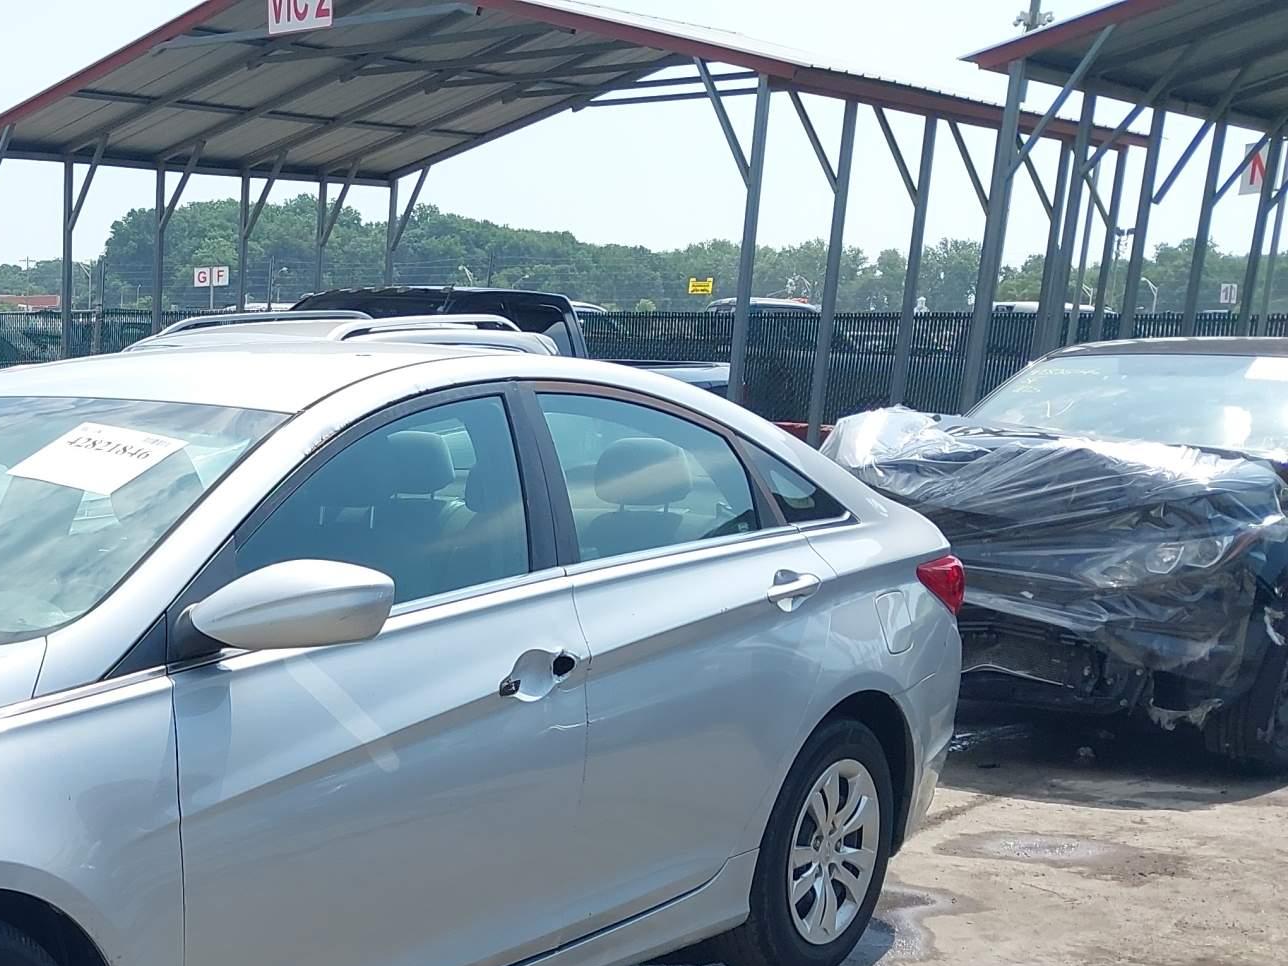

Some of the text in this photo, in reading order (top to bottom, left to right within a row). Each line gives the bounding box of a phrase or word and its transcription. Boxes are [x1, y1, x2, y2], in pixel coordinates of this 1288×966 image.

[197, 270, 224, 283] G F
[67, 436, 152, 460] 42821846
